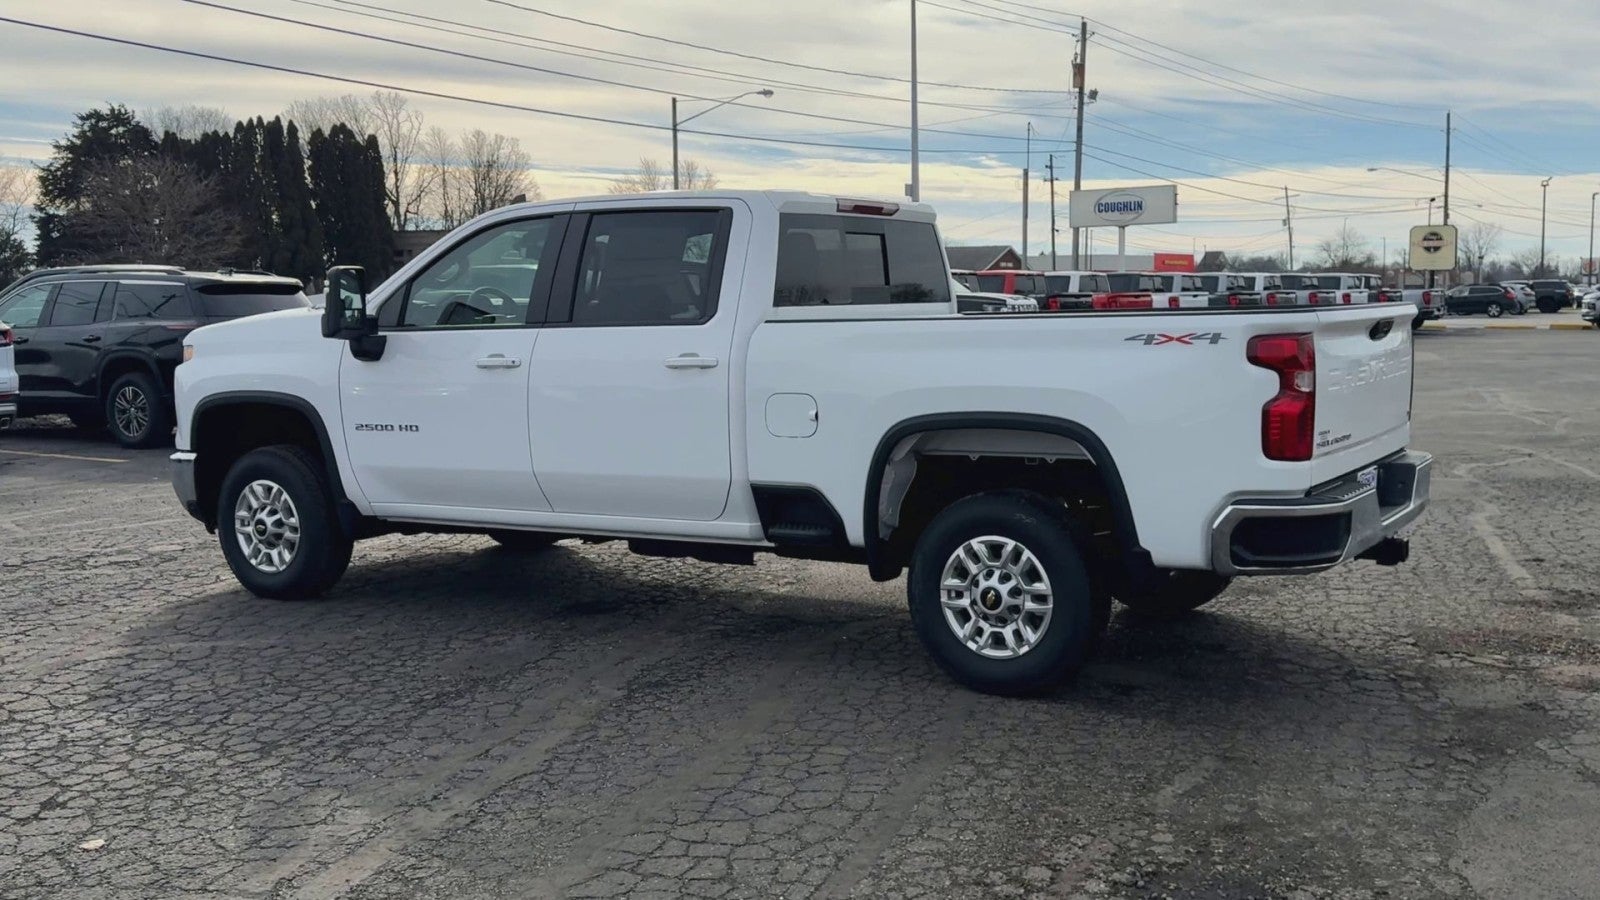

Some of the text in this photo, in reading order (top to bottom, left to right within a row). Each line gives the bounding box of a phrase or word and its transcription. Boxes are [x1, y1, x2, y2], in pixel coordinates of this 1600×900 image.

[1097, 200, 1143, 213] COUGHLIN
[355, 423, 419, 432] 2500 HD
